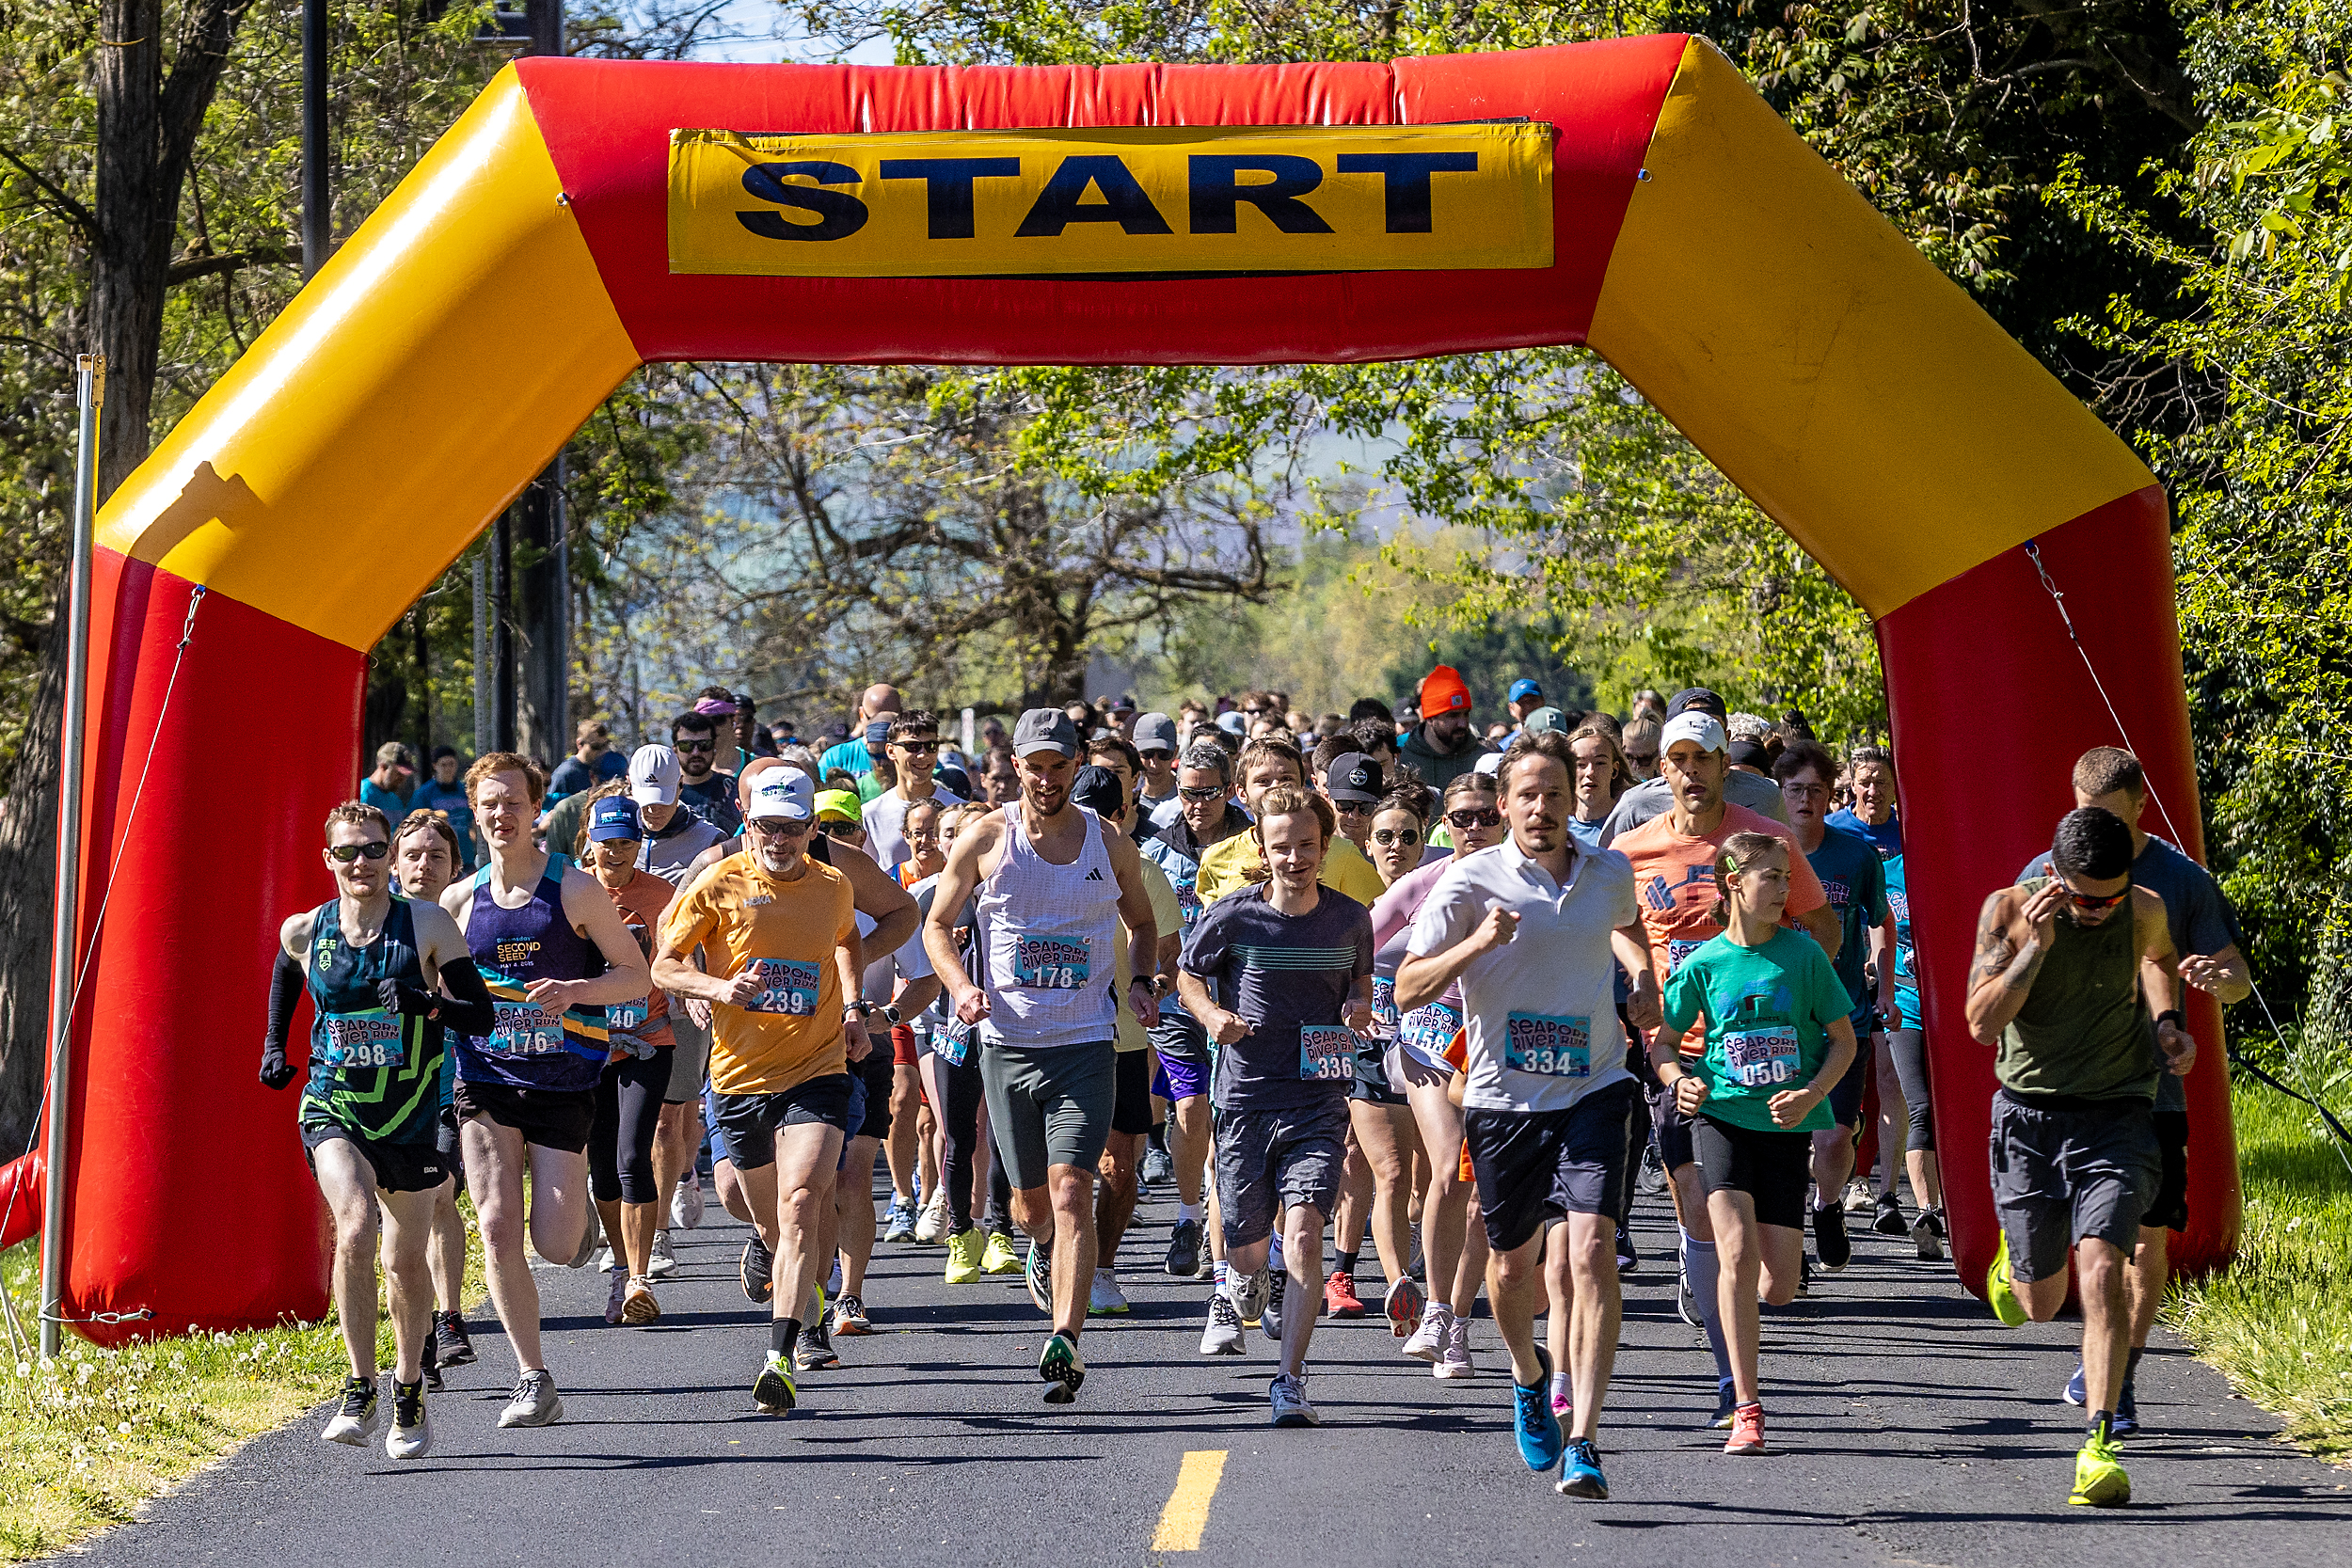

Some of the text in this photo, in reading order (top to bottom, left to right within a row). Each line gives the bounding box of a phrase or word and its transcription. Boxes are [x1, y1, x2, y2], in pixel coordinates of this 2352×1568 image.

[735, 151, 1479, 242] START
[743, 895, 771, 909] HOKA
[497, 942, 541, 954] SECOND
[499, 952, 526, 962] SEED
[1063, 953, 1088, 963] RUN
[793, 978, 818, 990] RUN
[1033, 966, 1073, 989] 178
[762, 990, 803, 1014] 239
[373, 1029, 399, 1038] RUN
[535, 1018, 561, 1027] RUN
[508, 1031, 548, 1053] 176
[931, 1034, 955, 1059] 289
[1410, 1027, 1445, 1053] 158
[1560, 1035, 1588, 1047] RUN
[1772, 1046, 1797, 1054] RUN
[342, 1043, 386, 1067] 298
[1524, 1049, 1571, 1074] 334
[1317, 1056, 1353, 1079] 336
[1742, 1060, 1786, 1085] 050
